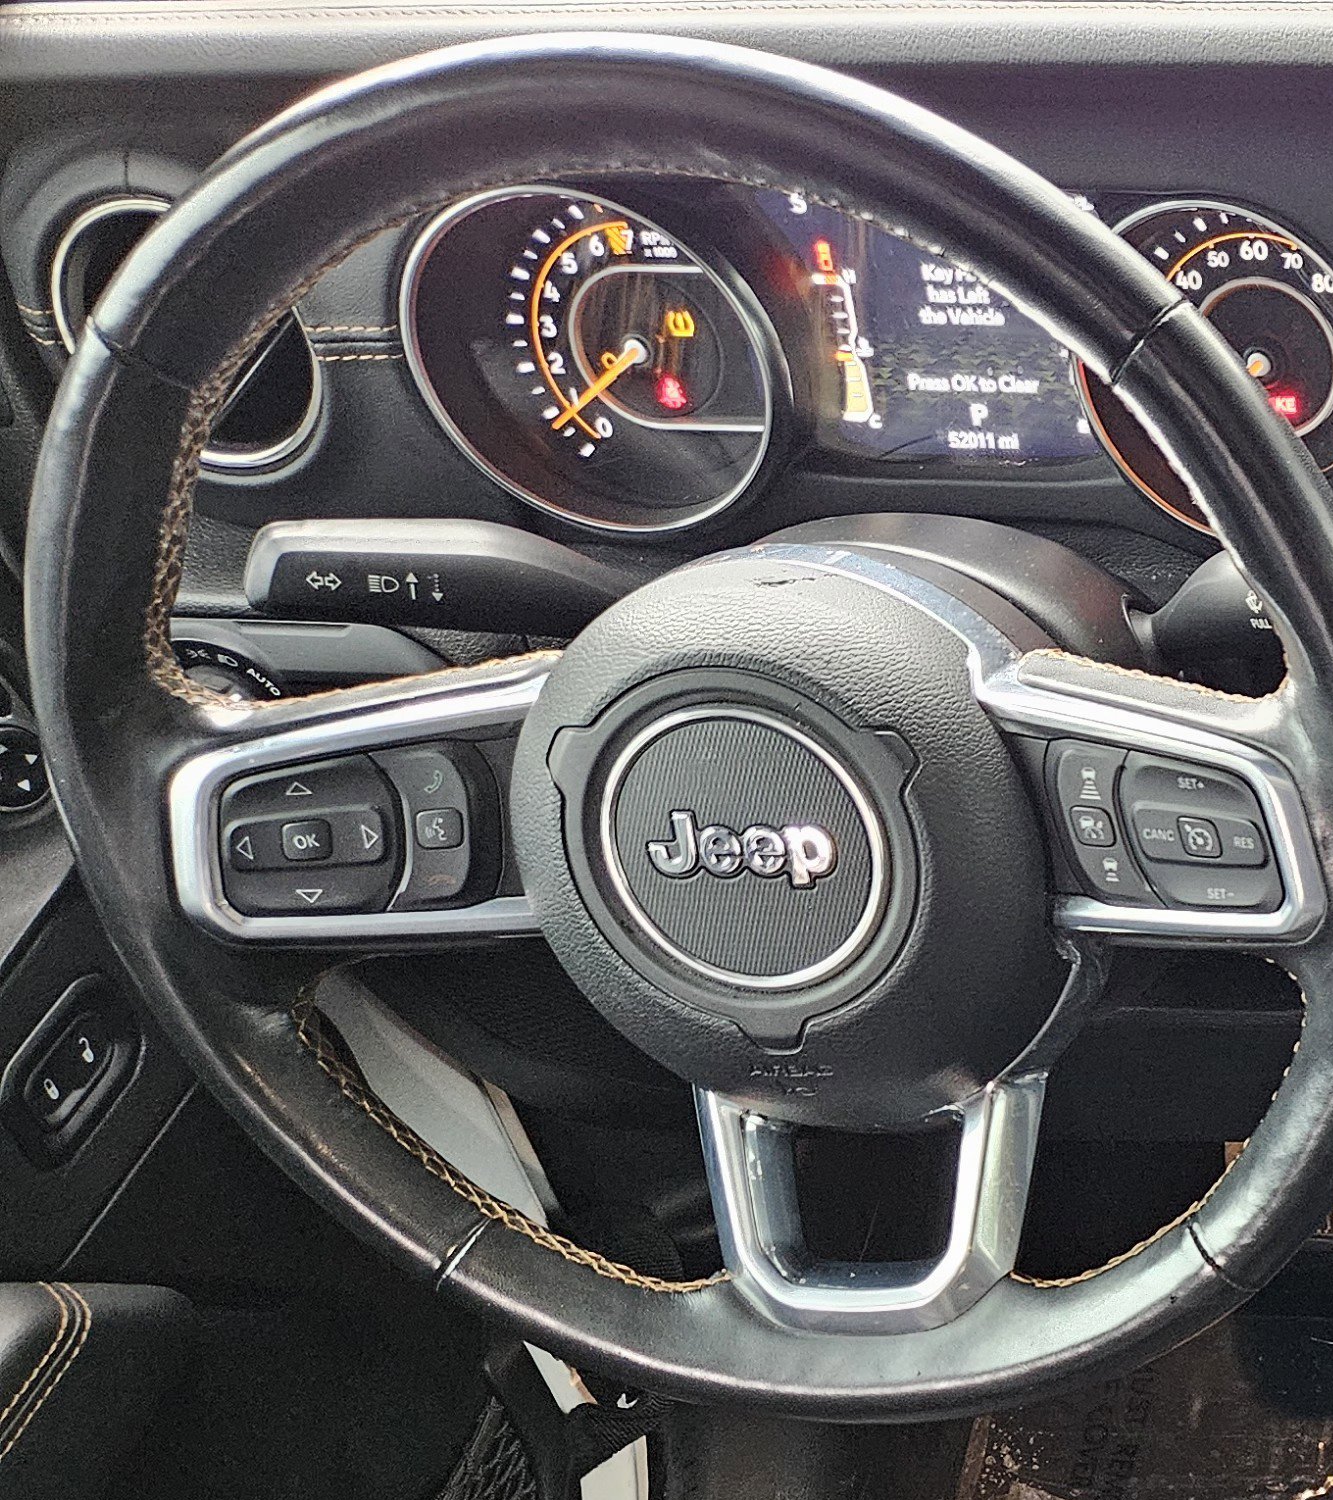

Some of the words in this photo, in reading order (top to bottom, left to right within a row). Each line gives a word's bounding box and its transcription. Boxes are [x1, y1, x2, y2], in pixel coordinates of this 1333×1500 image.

[590, 234, 604, 256] 6
[621, 229, 633, 254] 7
[1240, 240, 1269, 261] 60
[560, 252, 578, 275] 5
[1207, 250, 1230, 268] 50
[1281, 252, 1303, 270] 70
[1176, 268, 1202, 290] 40
[543, 280, 561, 302] 4
[540, 315, 557, 338] 3
[547, 352, 566, 374] 2
[907, 372, 950, 391] Press
[951, 374, 978, 392] OK
[979, 376, 997, 393] to
[998, 374, 1039, 393] Clear
[970, 403, 988, 427] P
[595, 417, 613, 437] 0
[948, 431, 995, 450] 52011
[998, 433, 1020, 450] mi
[246, 667, 281, 699] AUTO
[293, 834, 320, 850] OK
[1142, 827, 1175, 842] CANC
[1233, 836, 1255, 849] RES
[649, 809, 835, 887] Jeep
